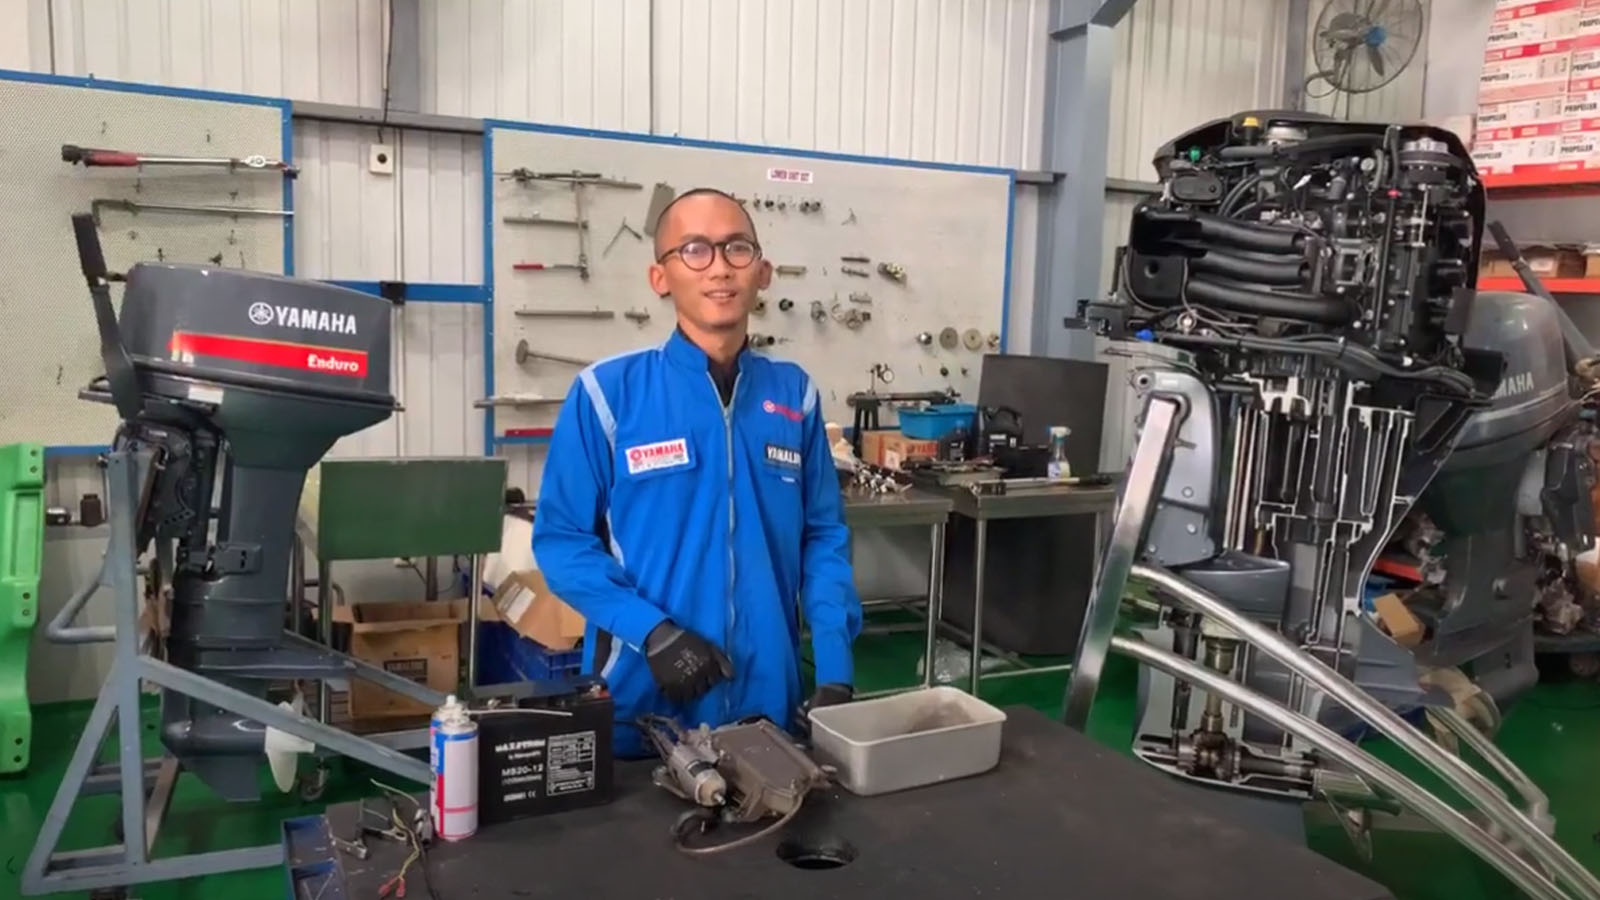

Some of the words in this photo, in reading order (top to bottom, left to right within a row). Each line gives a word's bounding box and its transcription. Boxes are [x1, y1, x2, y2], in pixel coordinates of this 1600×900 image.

[1488, 32, 1517, 41] PROPELLER
[1480, 74, 1509, 82] PROPELLER
[1565, 103, 1597, 112] PROPELLER
[1479, 114, 1506, 122] PROPELLER
[1561, 145, 1592, 154] PROPELLER
[1473, 152, 1501, 160] PROPELLER
[275, 305, 357, 335] YAMAHA
[308, 353, 358, 372] Enduro
[643, 442, 684, 459] YAMAHA
